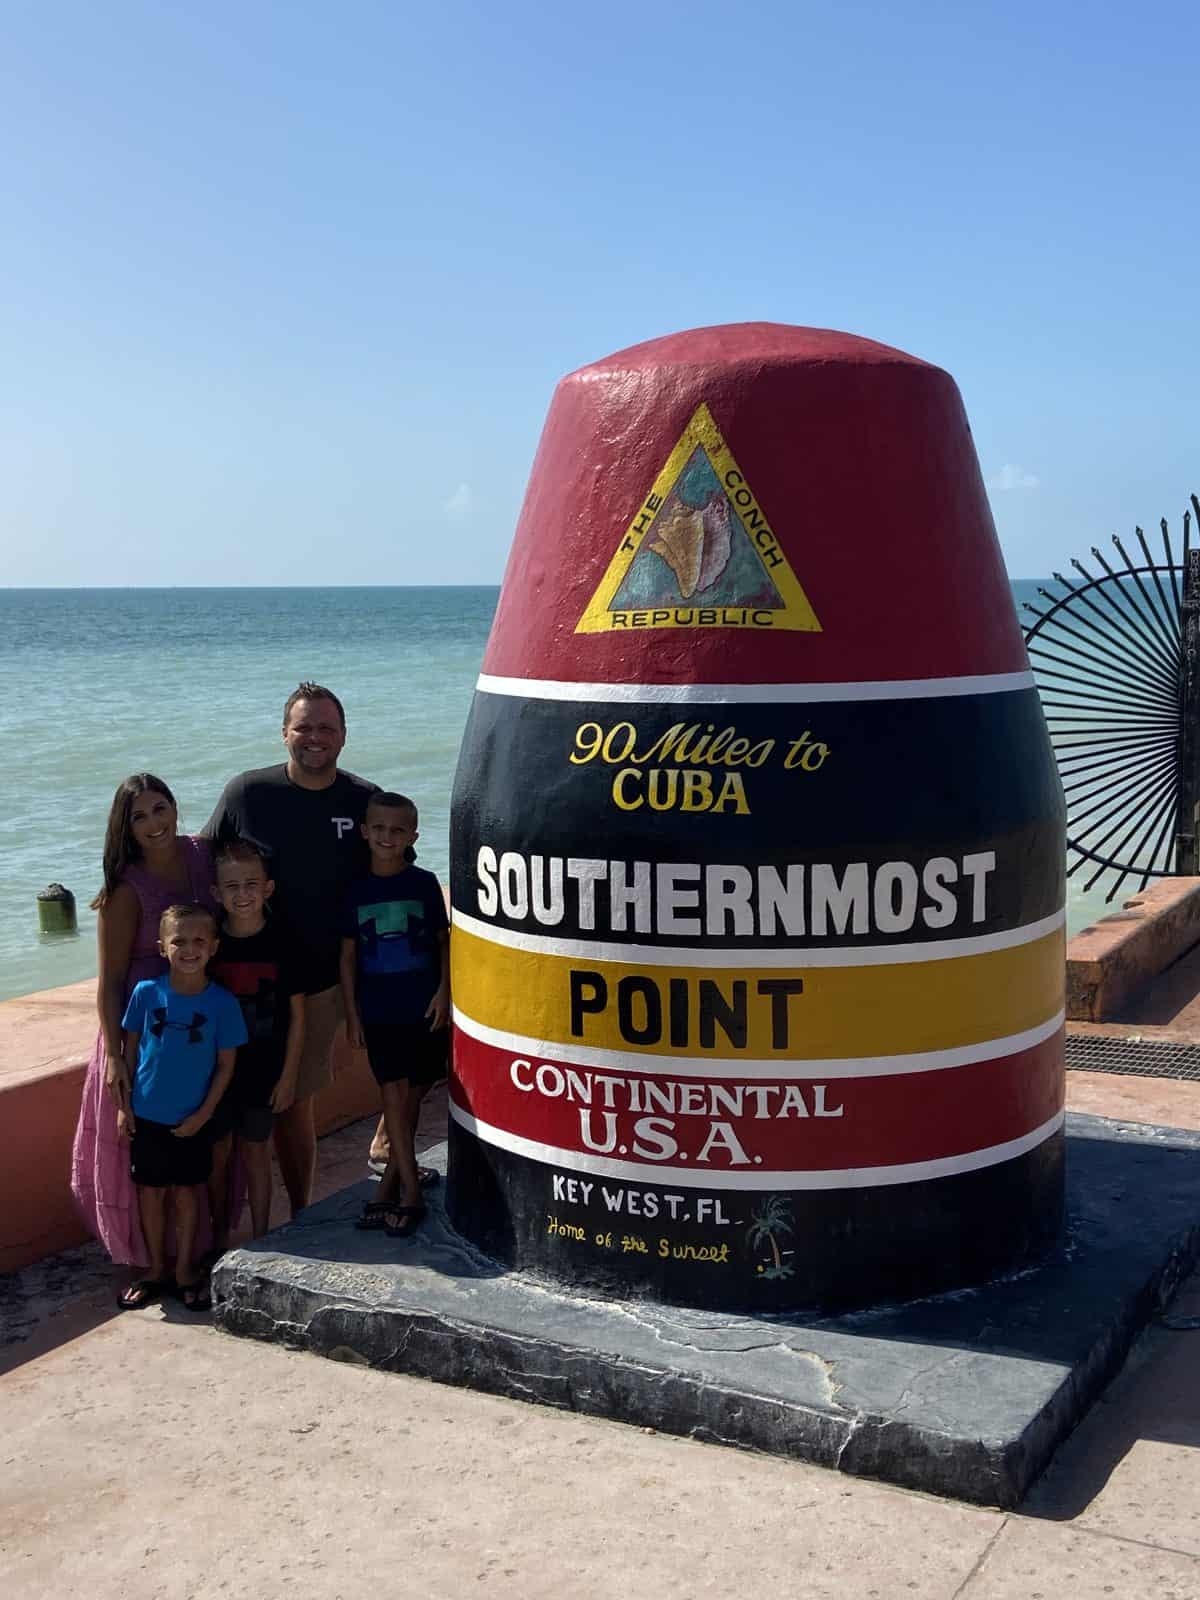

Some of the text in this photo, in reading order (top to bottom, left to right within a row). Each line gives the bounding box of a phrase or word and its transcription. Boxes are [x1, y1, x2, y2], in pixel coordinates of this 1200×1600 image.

[620, 492, 663, 551] THE
[725, 470, 783, 568] CONCH
[611, 610, 774, 628] REPUBLIC
[568, 722, 830, 772] 90 Miles to
[612, 768, 751, 815] CUBA
[476, 845, 996, 936] SOUTHERNMOST
[570, 970, 803, 1050] POINT
[510, 1060, 844, 1119] CONTINENTAL
[579, 1108, 763, 1165] U.S.A.
[552, 1174, 594, 1206] KEY
[602, 1186, 691, 1221] WEST,
[547, 1214, 731, 1264] Home of the Sunset
